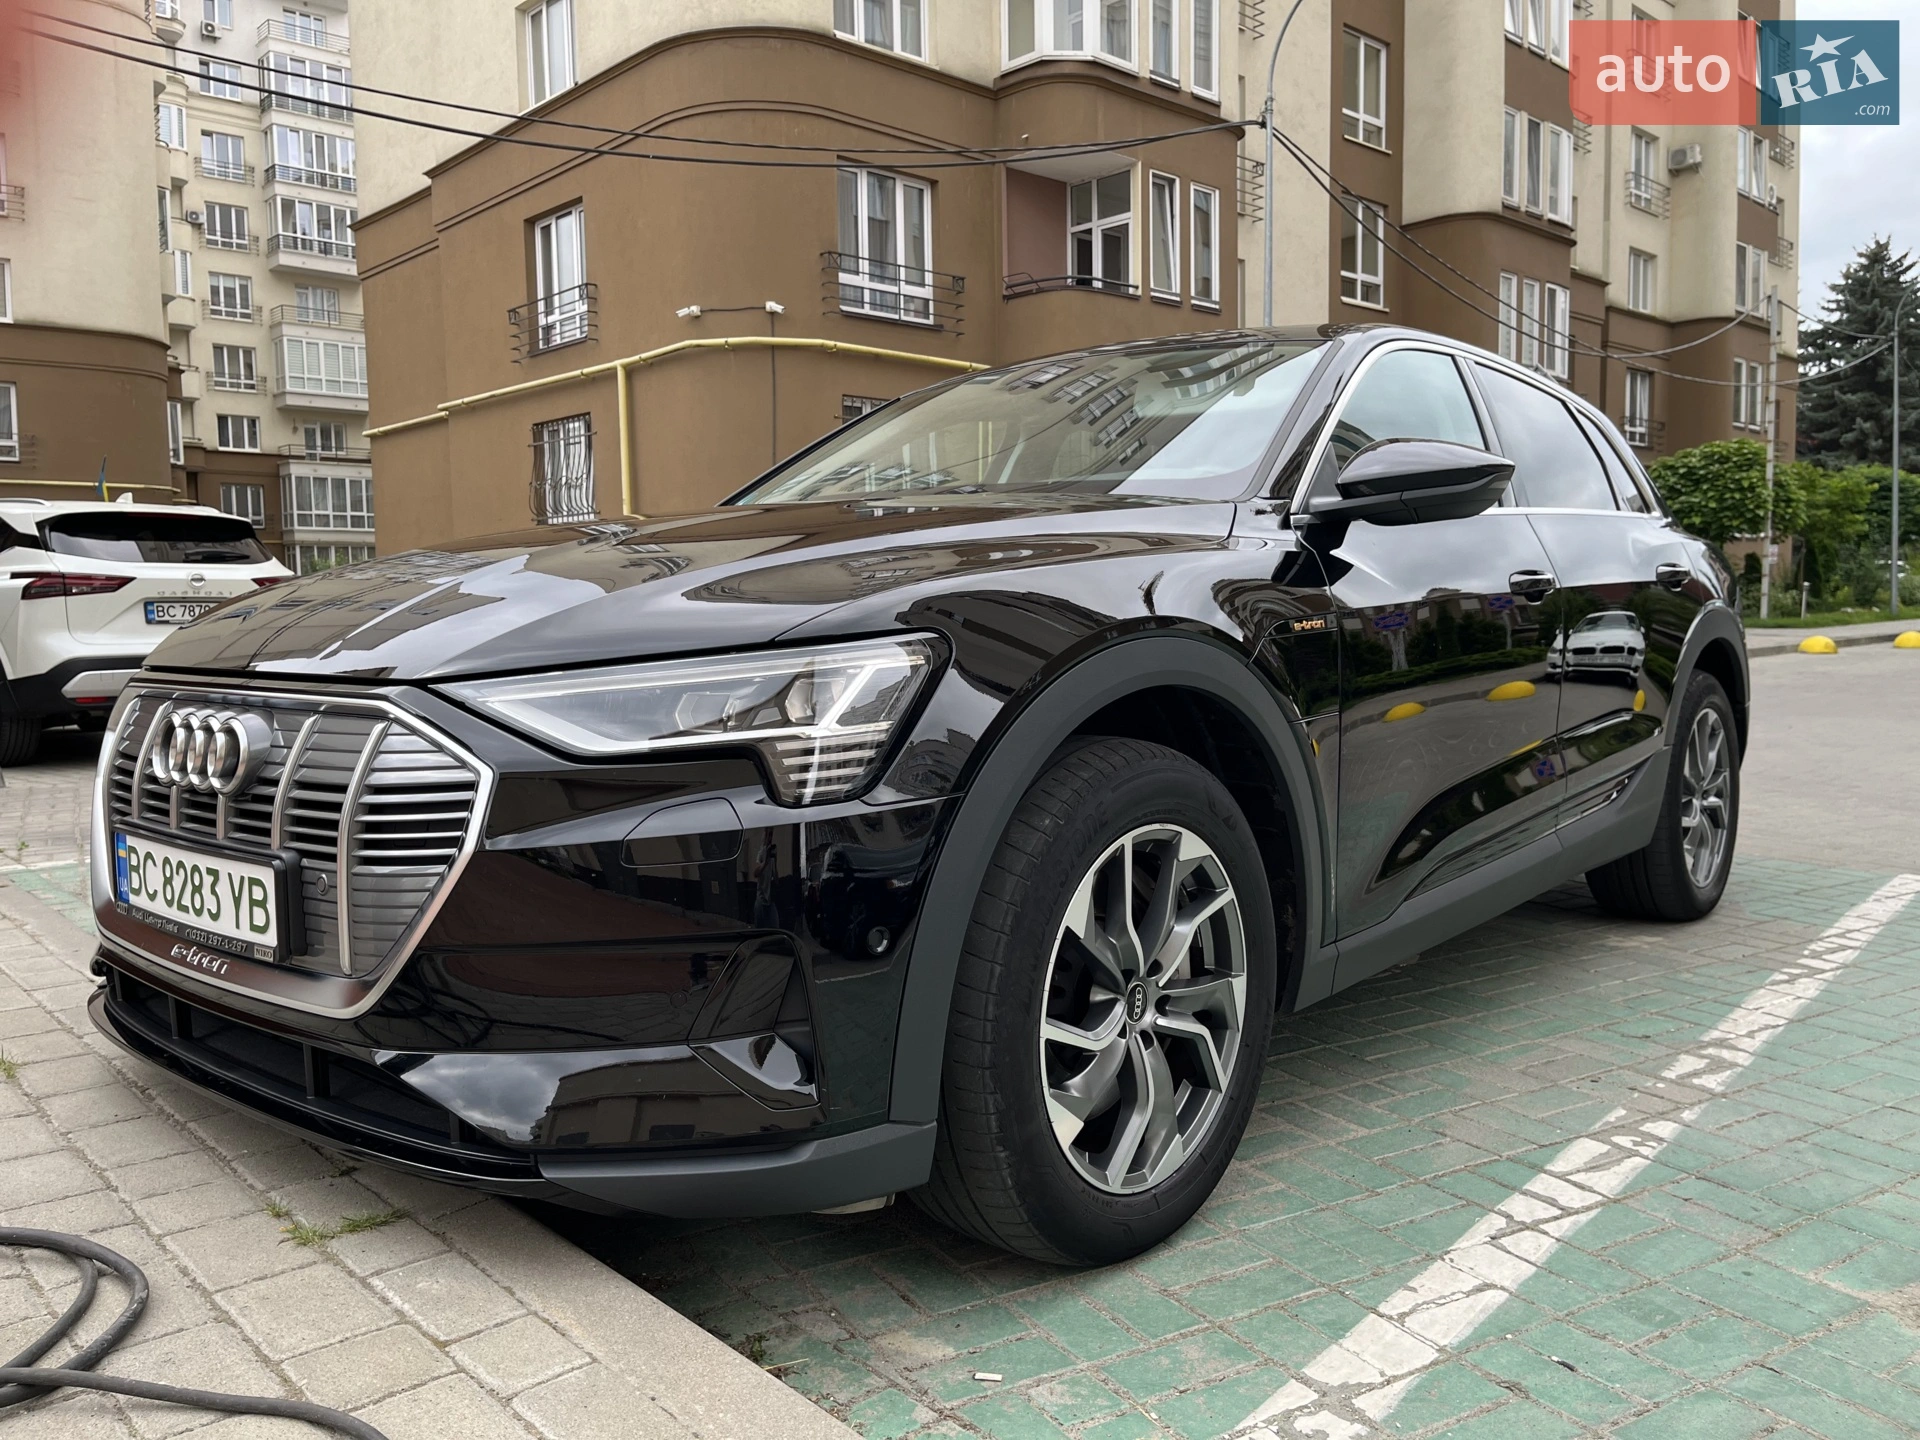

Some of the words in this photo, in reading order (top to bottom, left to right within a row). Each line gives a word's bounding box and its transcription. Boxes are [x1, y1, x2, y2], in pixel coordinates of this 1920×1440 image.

[156, 605, 177, 618] BC
[1293, 619, 1325, 631] e-tron
[119, 876, 129, 894] UA
[127, 845, 158, 902] BC
[162, 856, 221, 922] 8283
[227, 872, 270, 935] YB
[170, 943, 231, 974] e-tron
[255, 948, 273, 960] NIKO
